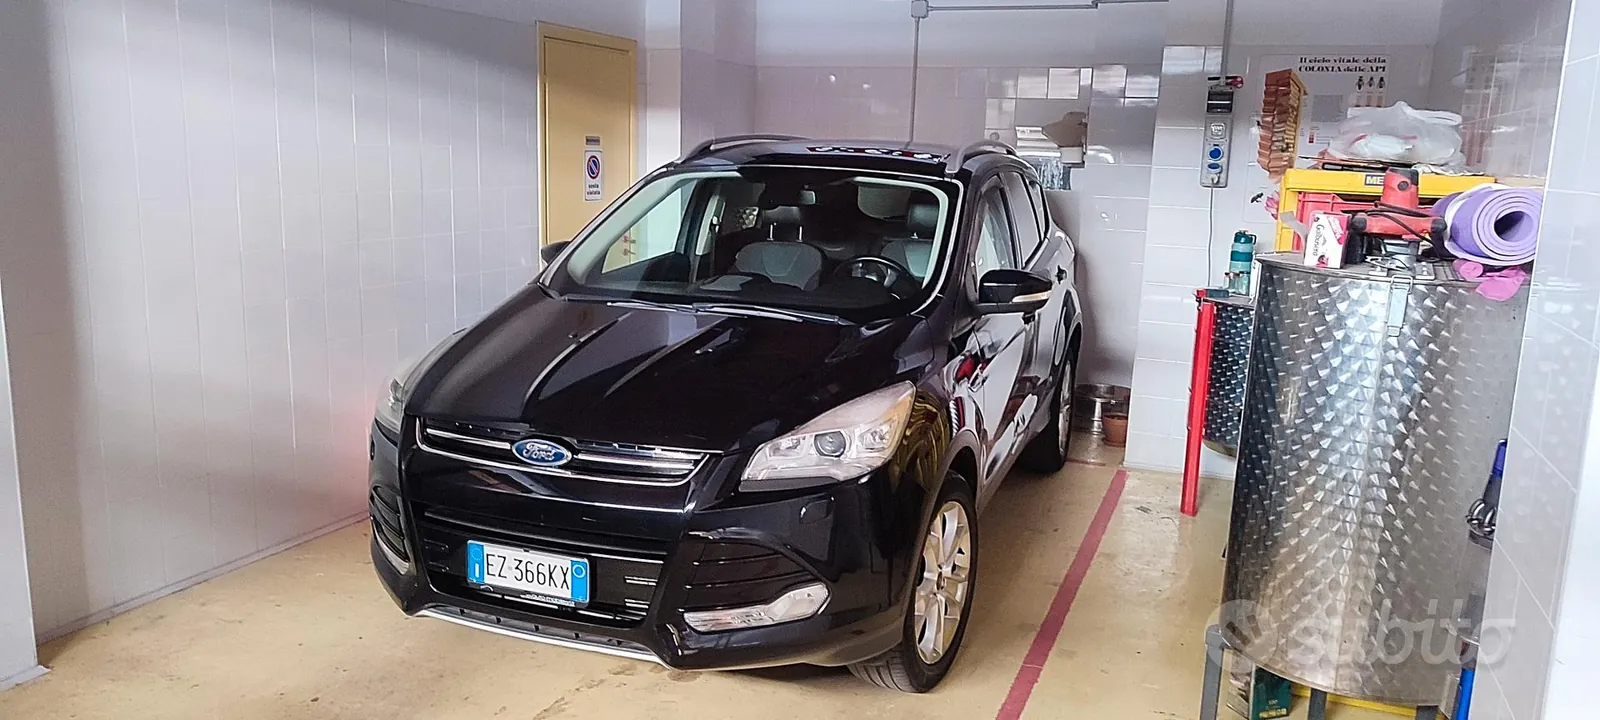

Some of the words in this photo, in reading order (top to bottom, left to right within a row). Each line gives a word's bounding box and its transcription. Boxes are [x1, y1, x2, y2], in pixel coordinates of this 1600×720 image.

[1298, 65, 1342, 73] COLONIA
[1343, 65, 1366, 73] delle
[1367, 65, 1386, 73] API
[522, 442, 557, 461] Ford
[513, 558, 570, 591] 366KX
